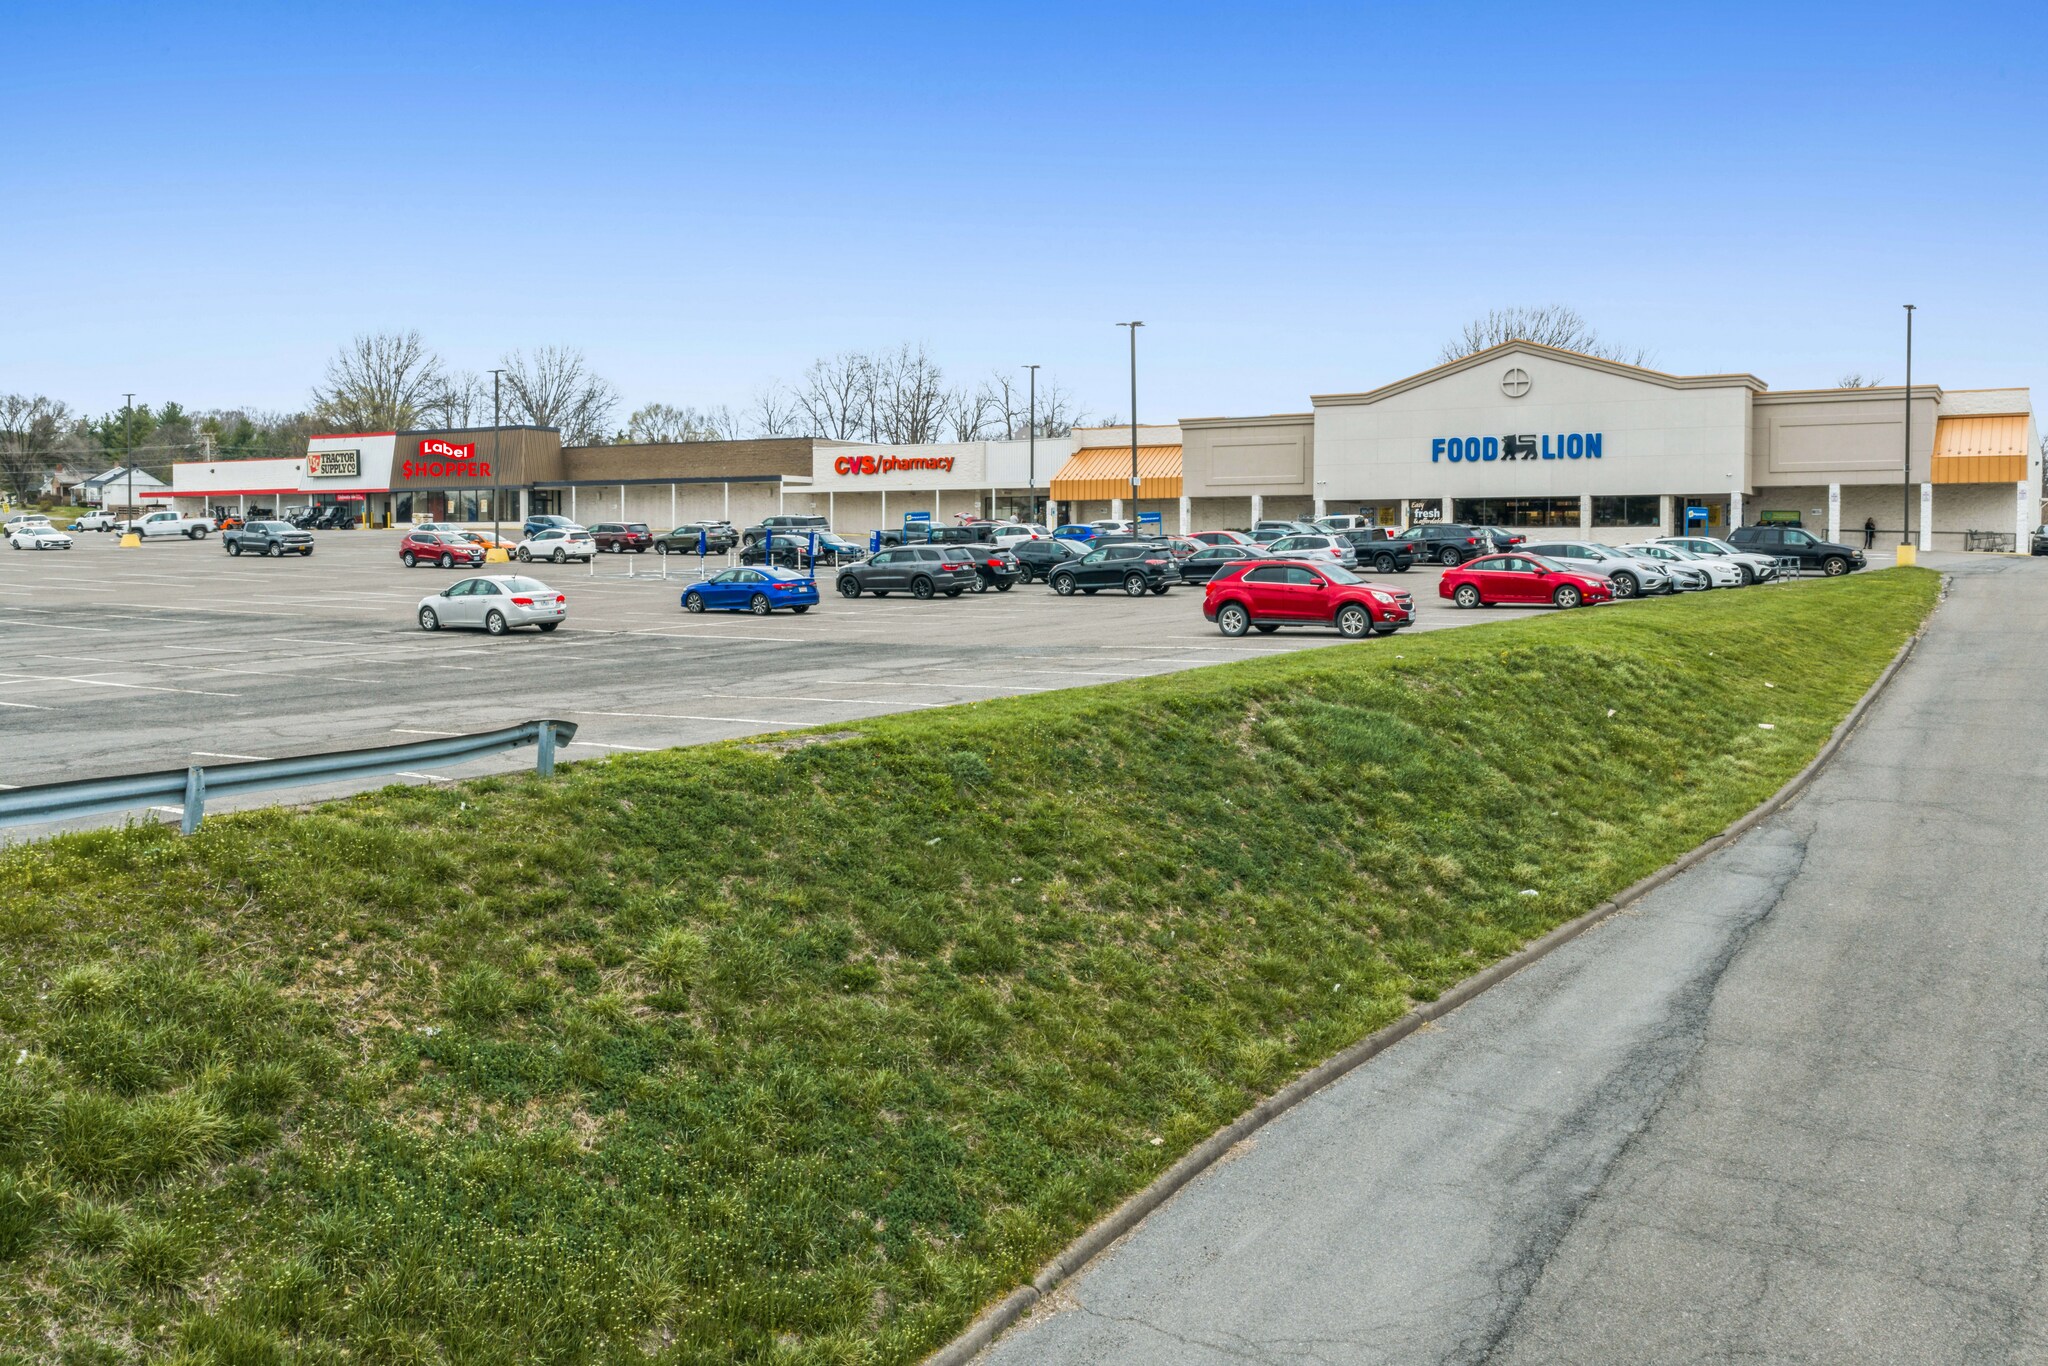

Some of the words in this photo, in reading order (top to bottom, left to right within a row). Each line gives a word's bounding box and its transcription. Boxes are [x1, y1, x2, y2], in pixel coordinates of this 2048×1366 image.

[424, 441, 468, 458] Label
[1432, 437, 1498, 462] FOOD
[1542, 433, 1602, 459] LION
[321, 453, 355, 463] TRACTOR
[834, 455, 955, 475] CVS/pharmacy
[321, 464, 346, 474] SUPPLY
[402, 459, 491, 480] $HOPPER
[1414, 508, 1440, 517] fresh
